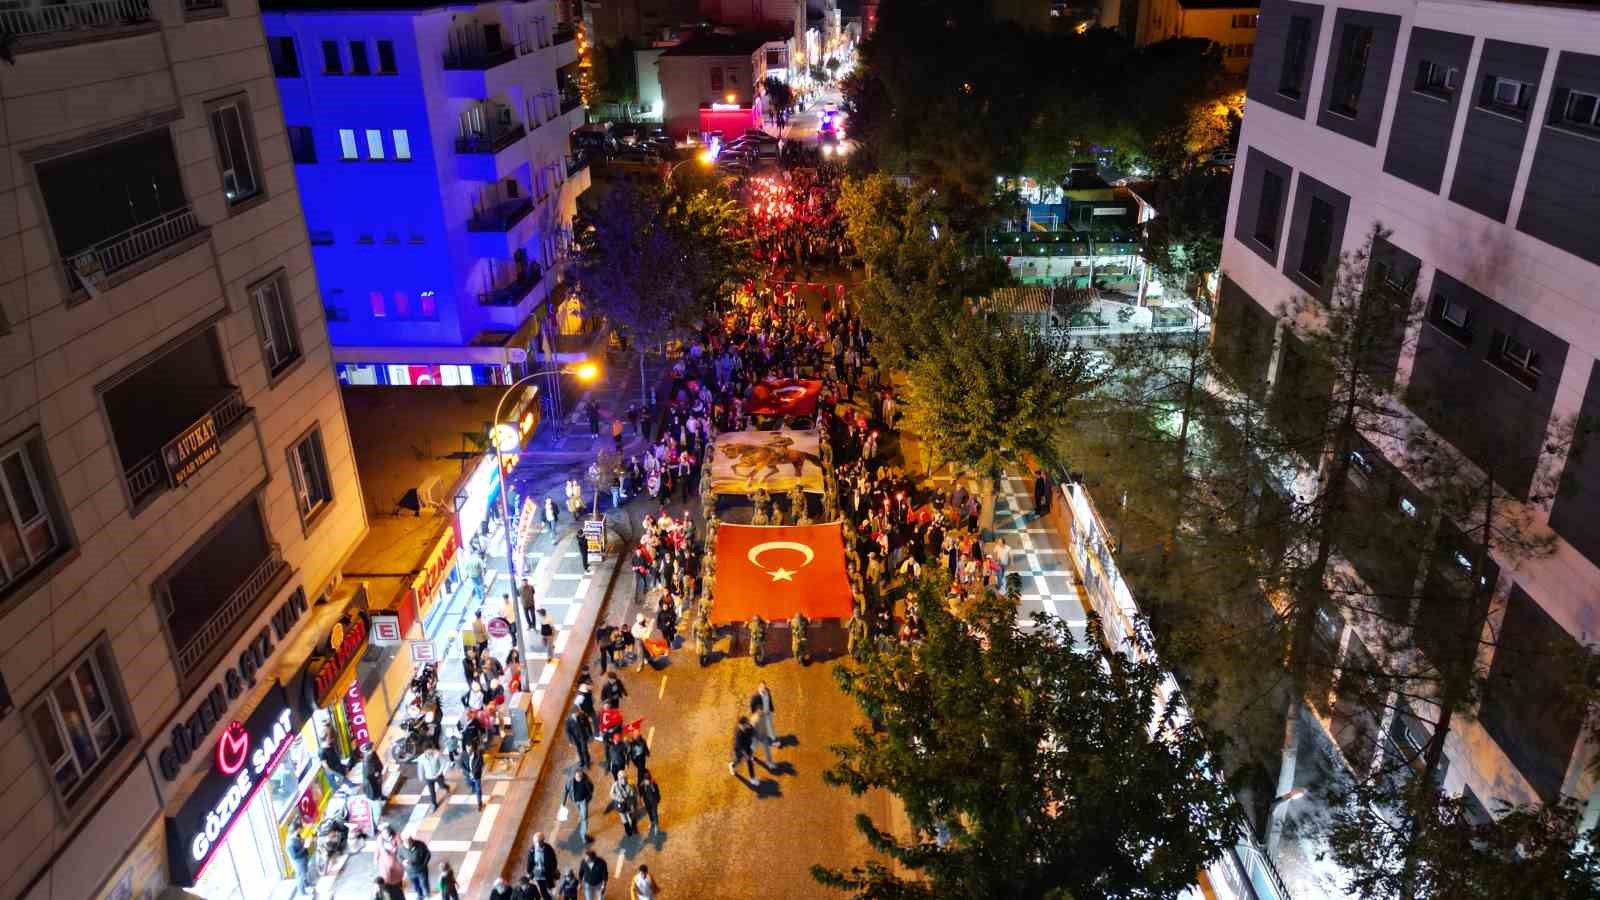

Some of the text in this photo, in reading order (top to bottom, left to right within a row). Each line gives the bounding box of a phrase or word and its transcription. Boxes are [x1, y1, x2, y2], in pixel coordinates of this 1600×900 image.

[178, 420, 215, 461] AVUKAT
[225, 668, 243, 700] &
[272, 584, 308, 640] YAPI
[379, 625, 394, 638] E
[416, 646, 430, 659] E
[192, 708, 292, 861] GÖZDE SAAT
